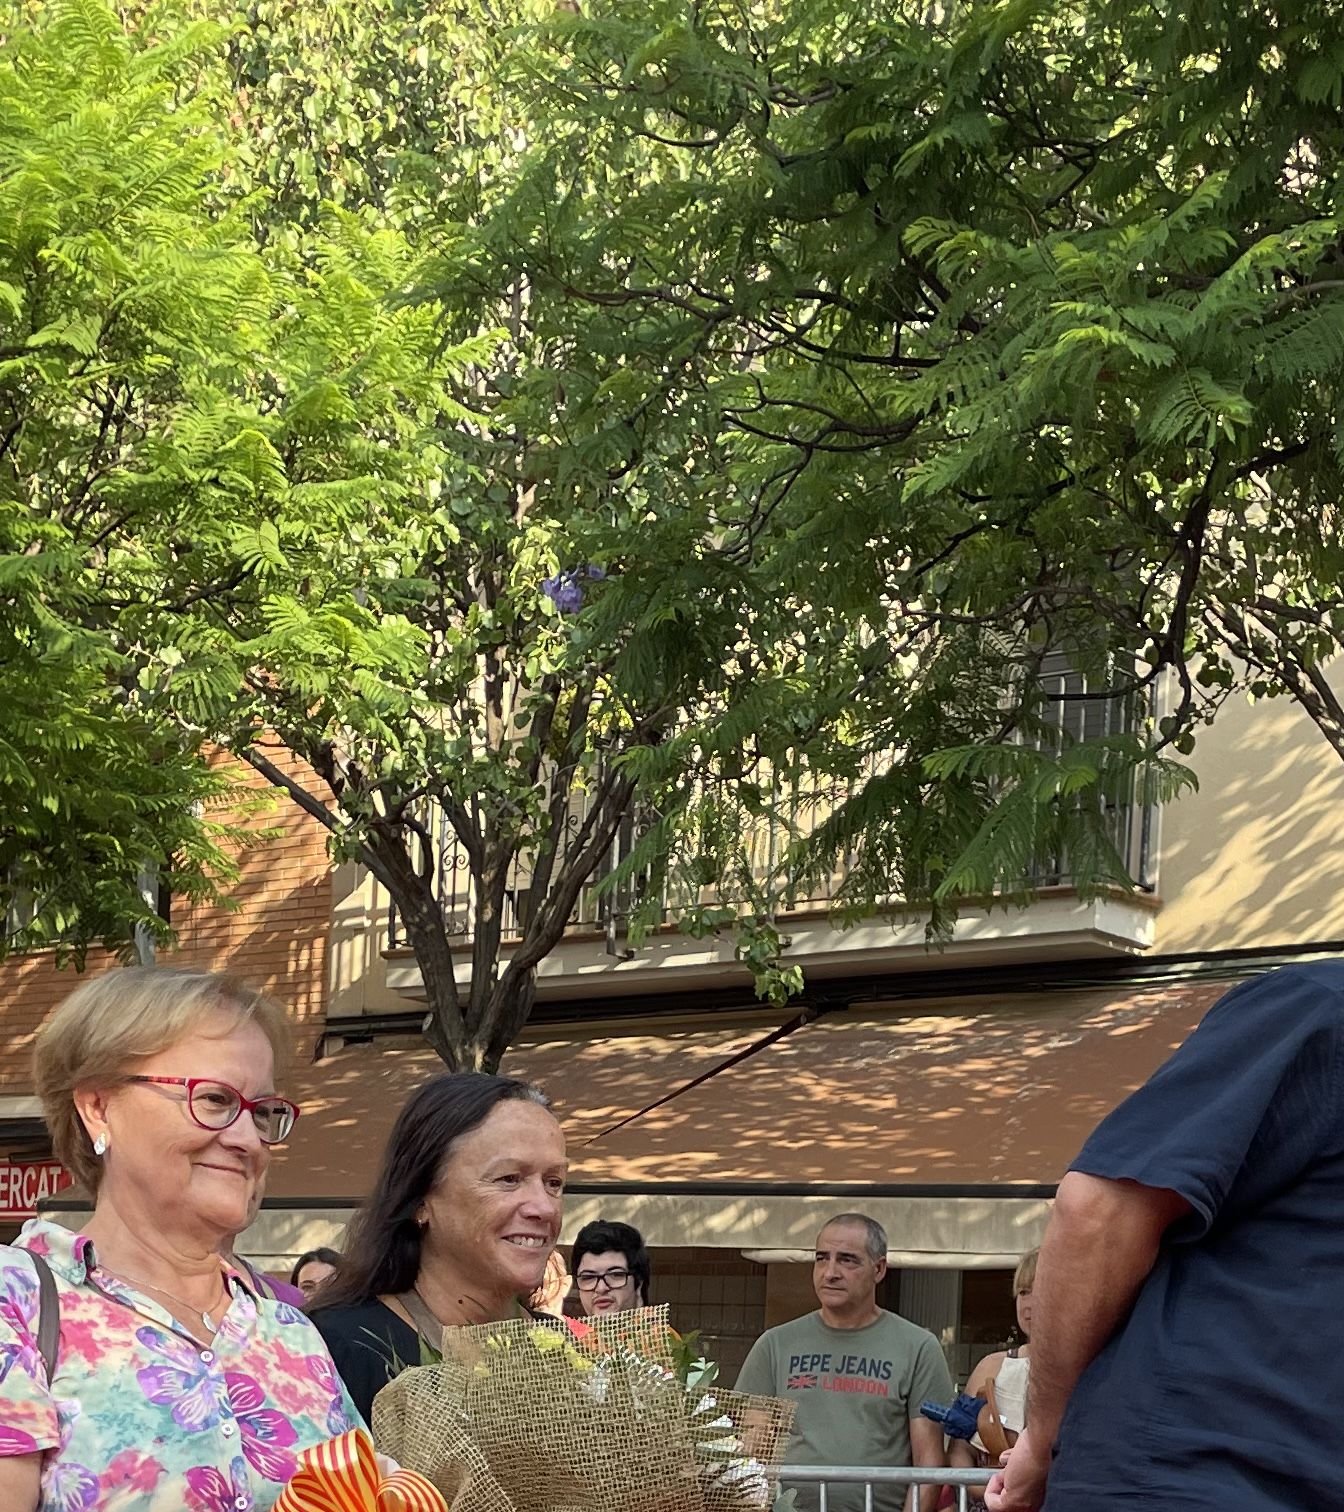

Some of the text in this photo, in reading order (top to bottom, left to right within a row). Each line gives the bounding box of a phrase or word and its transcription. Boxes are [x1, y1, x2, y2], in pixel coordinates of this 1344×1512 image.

[789, 1354, 893, 1380] PEPE JEANS
[821, 1375, 889, 1398] LONDON
